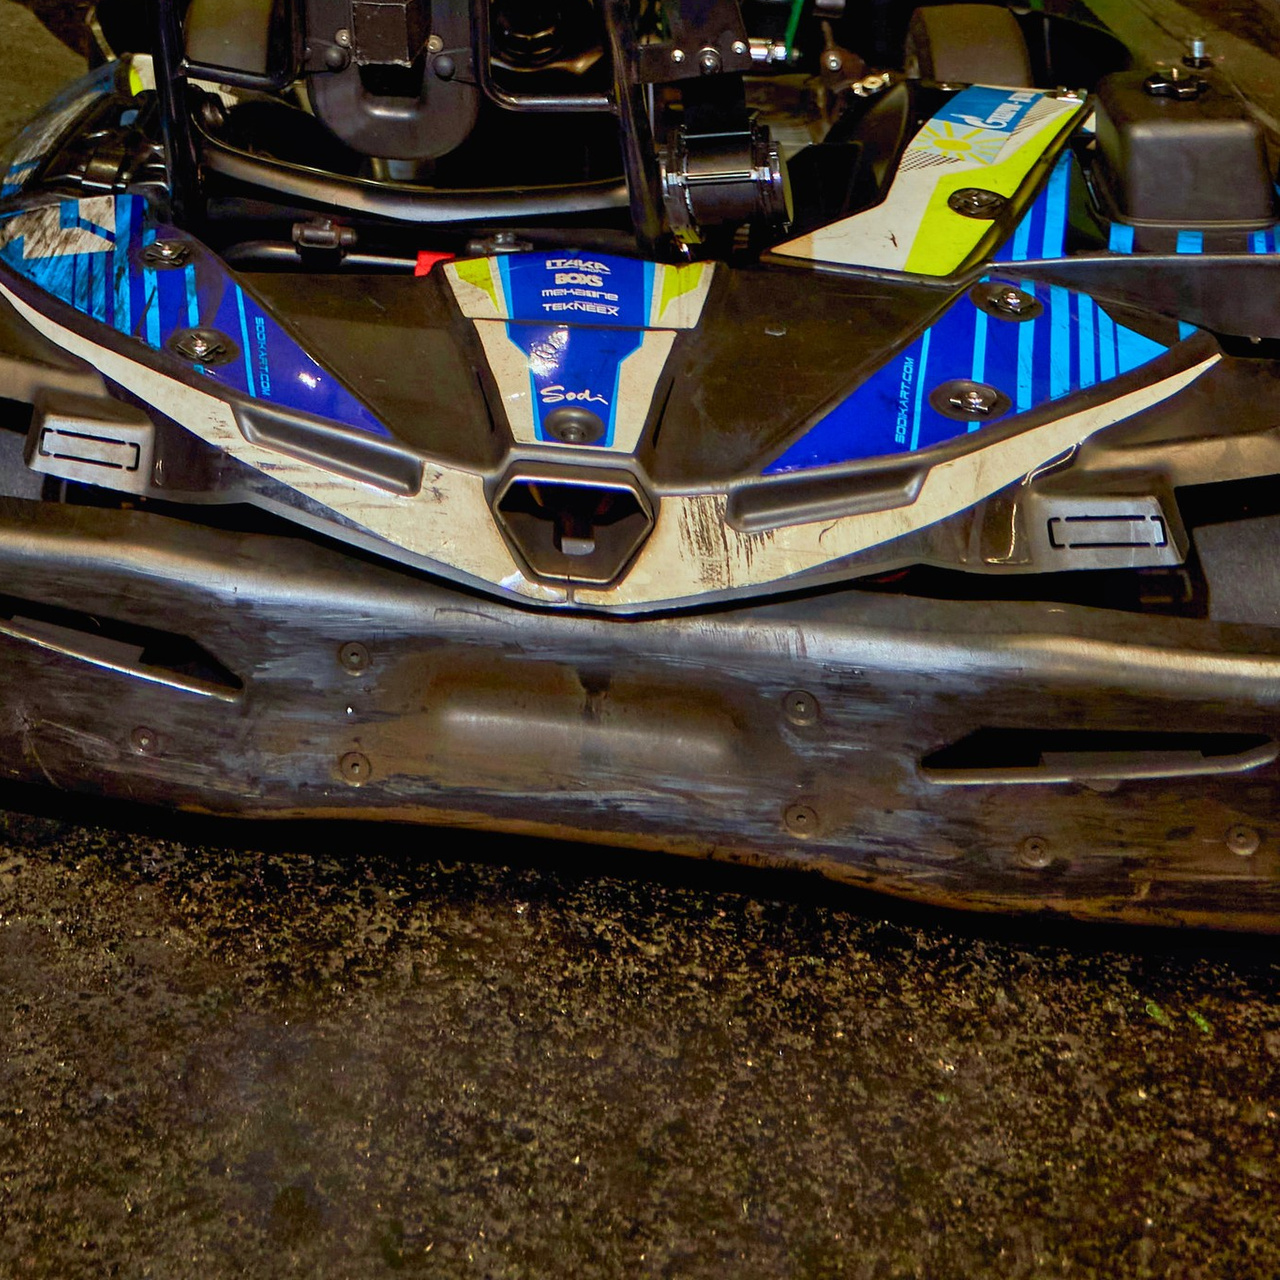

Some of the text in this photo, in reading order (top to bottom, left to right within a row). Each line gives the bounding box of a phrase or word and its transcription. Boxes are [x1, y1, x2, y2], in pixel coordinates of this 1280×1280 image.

[255, 316, 271, 398] SODIKART.COM
[540, 385, 609, 406] Sodi
[894, 355, 915, 445] SODIKART.COM
